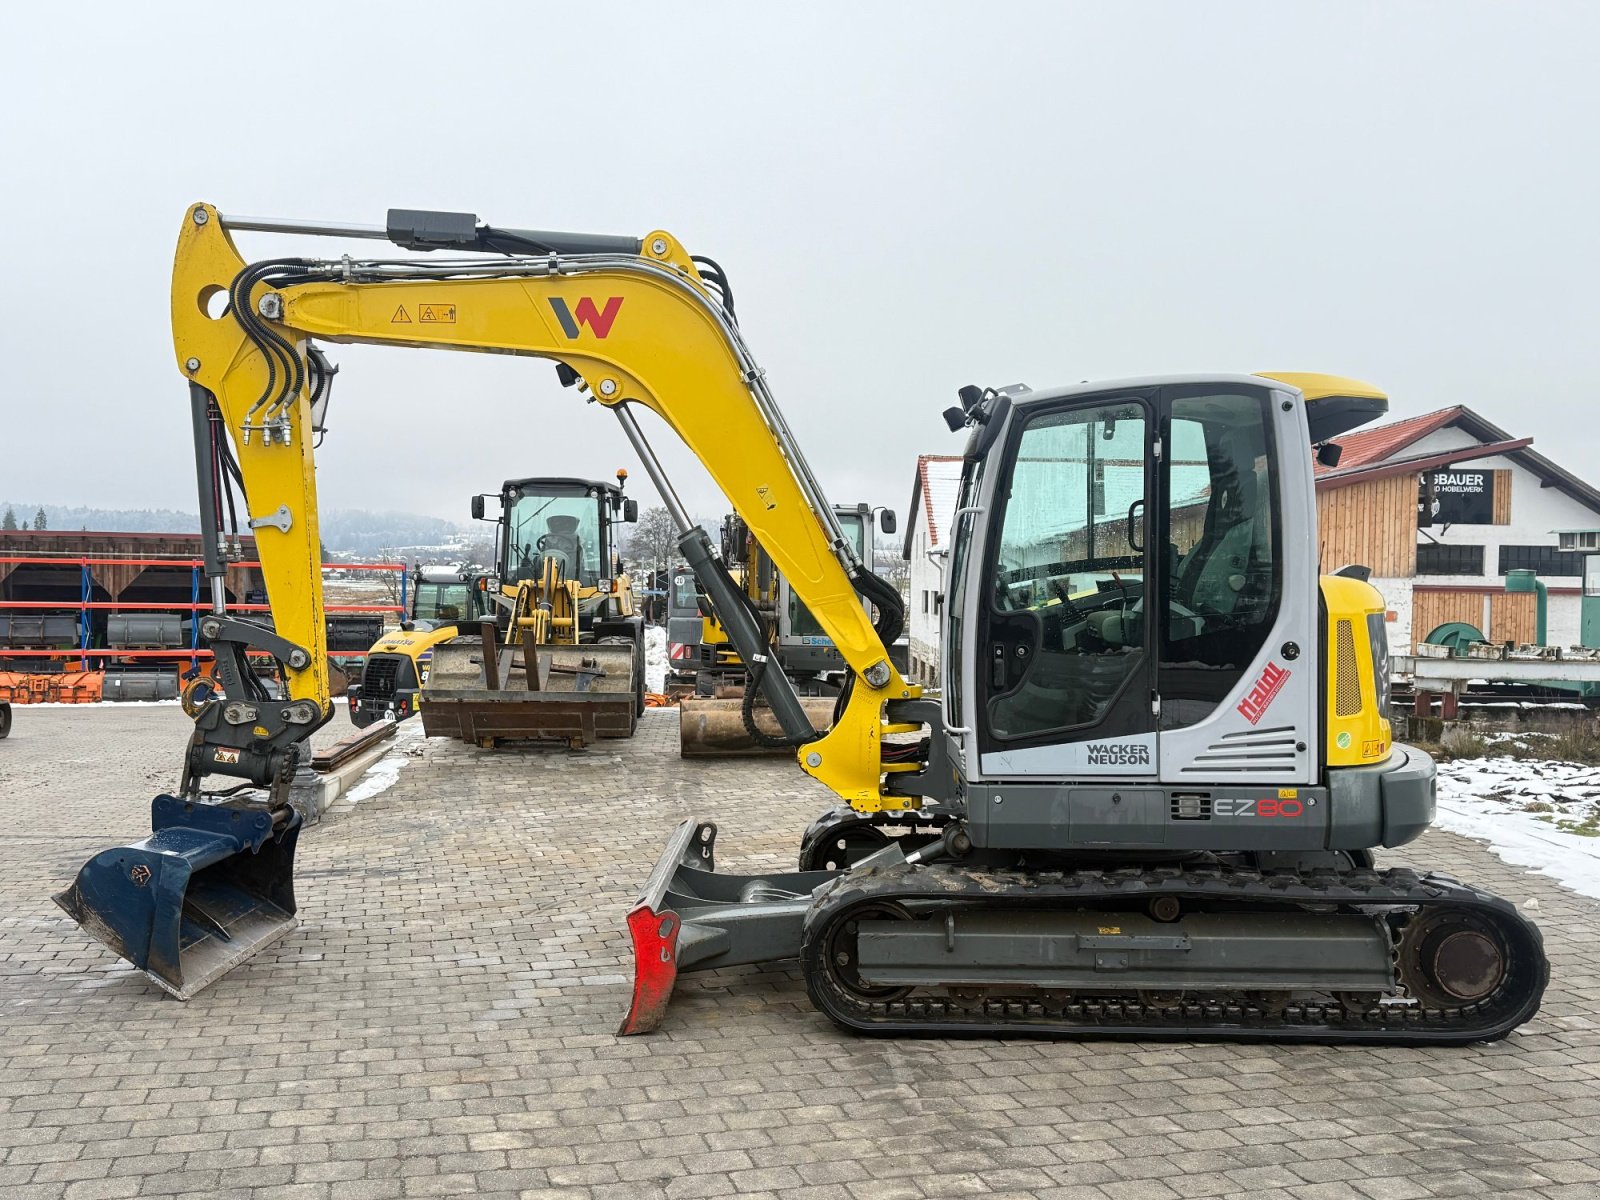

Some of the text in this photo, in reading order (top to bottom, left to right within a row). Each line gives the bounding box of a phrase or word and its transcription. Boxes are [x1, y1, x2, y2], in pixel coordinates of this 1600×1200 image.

[1087, 744, 1149, 755] WACKER
[1088, 754, 1150, 765] NEUSON
[1214, 799, 1303, 817] EZ80
